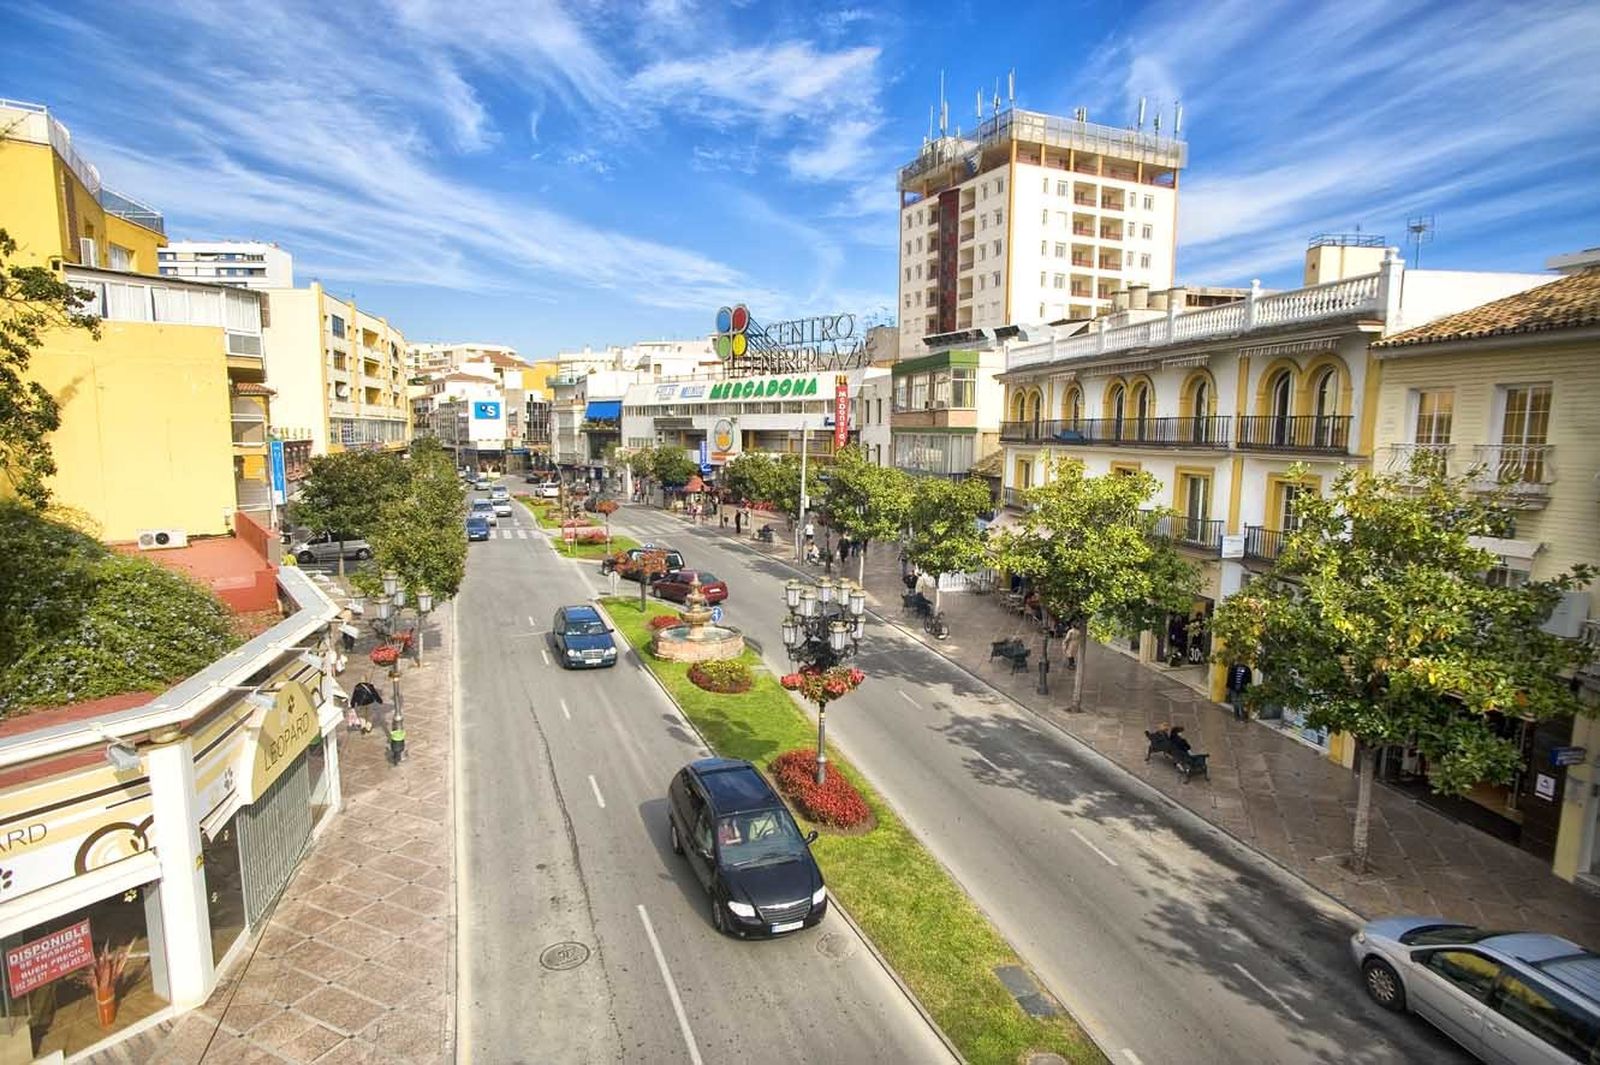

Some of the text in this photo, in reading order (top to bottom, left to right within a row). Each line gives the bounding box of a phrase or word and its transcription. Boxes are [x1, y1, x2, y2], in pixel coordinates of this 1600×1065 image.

[763, 313, 855, 347] CENTRO
[709, 378, 817, 400] MERCADONA
[263, 712, 310, 772] LEOPARD
[9, 923, 90, 965] DISPONIBLE
[36, 938, 84, 962] TRASPASA
[50, 946, 85, 967] PRECIO
